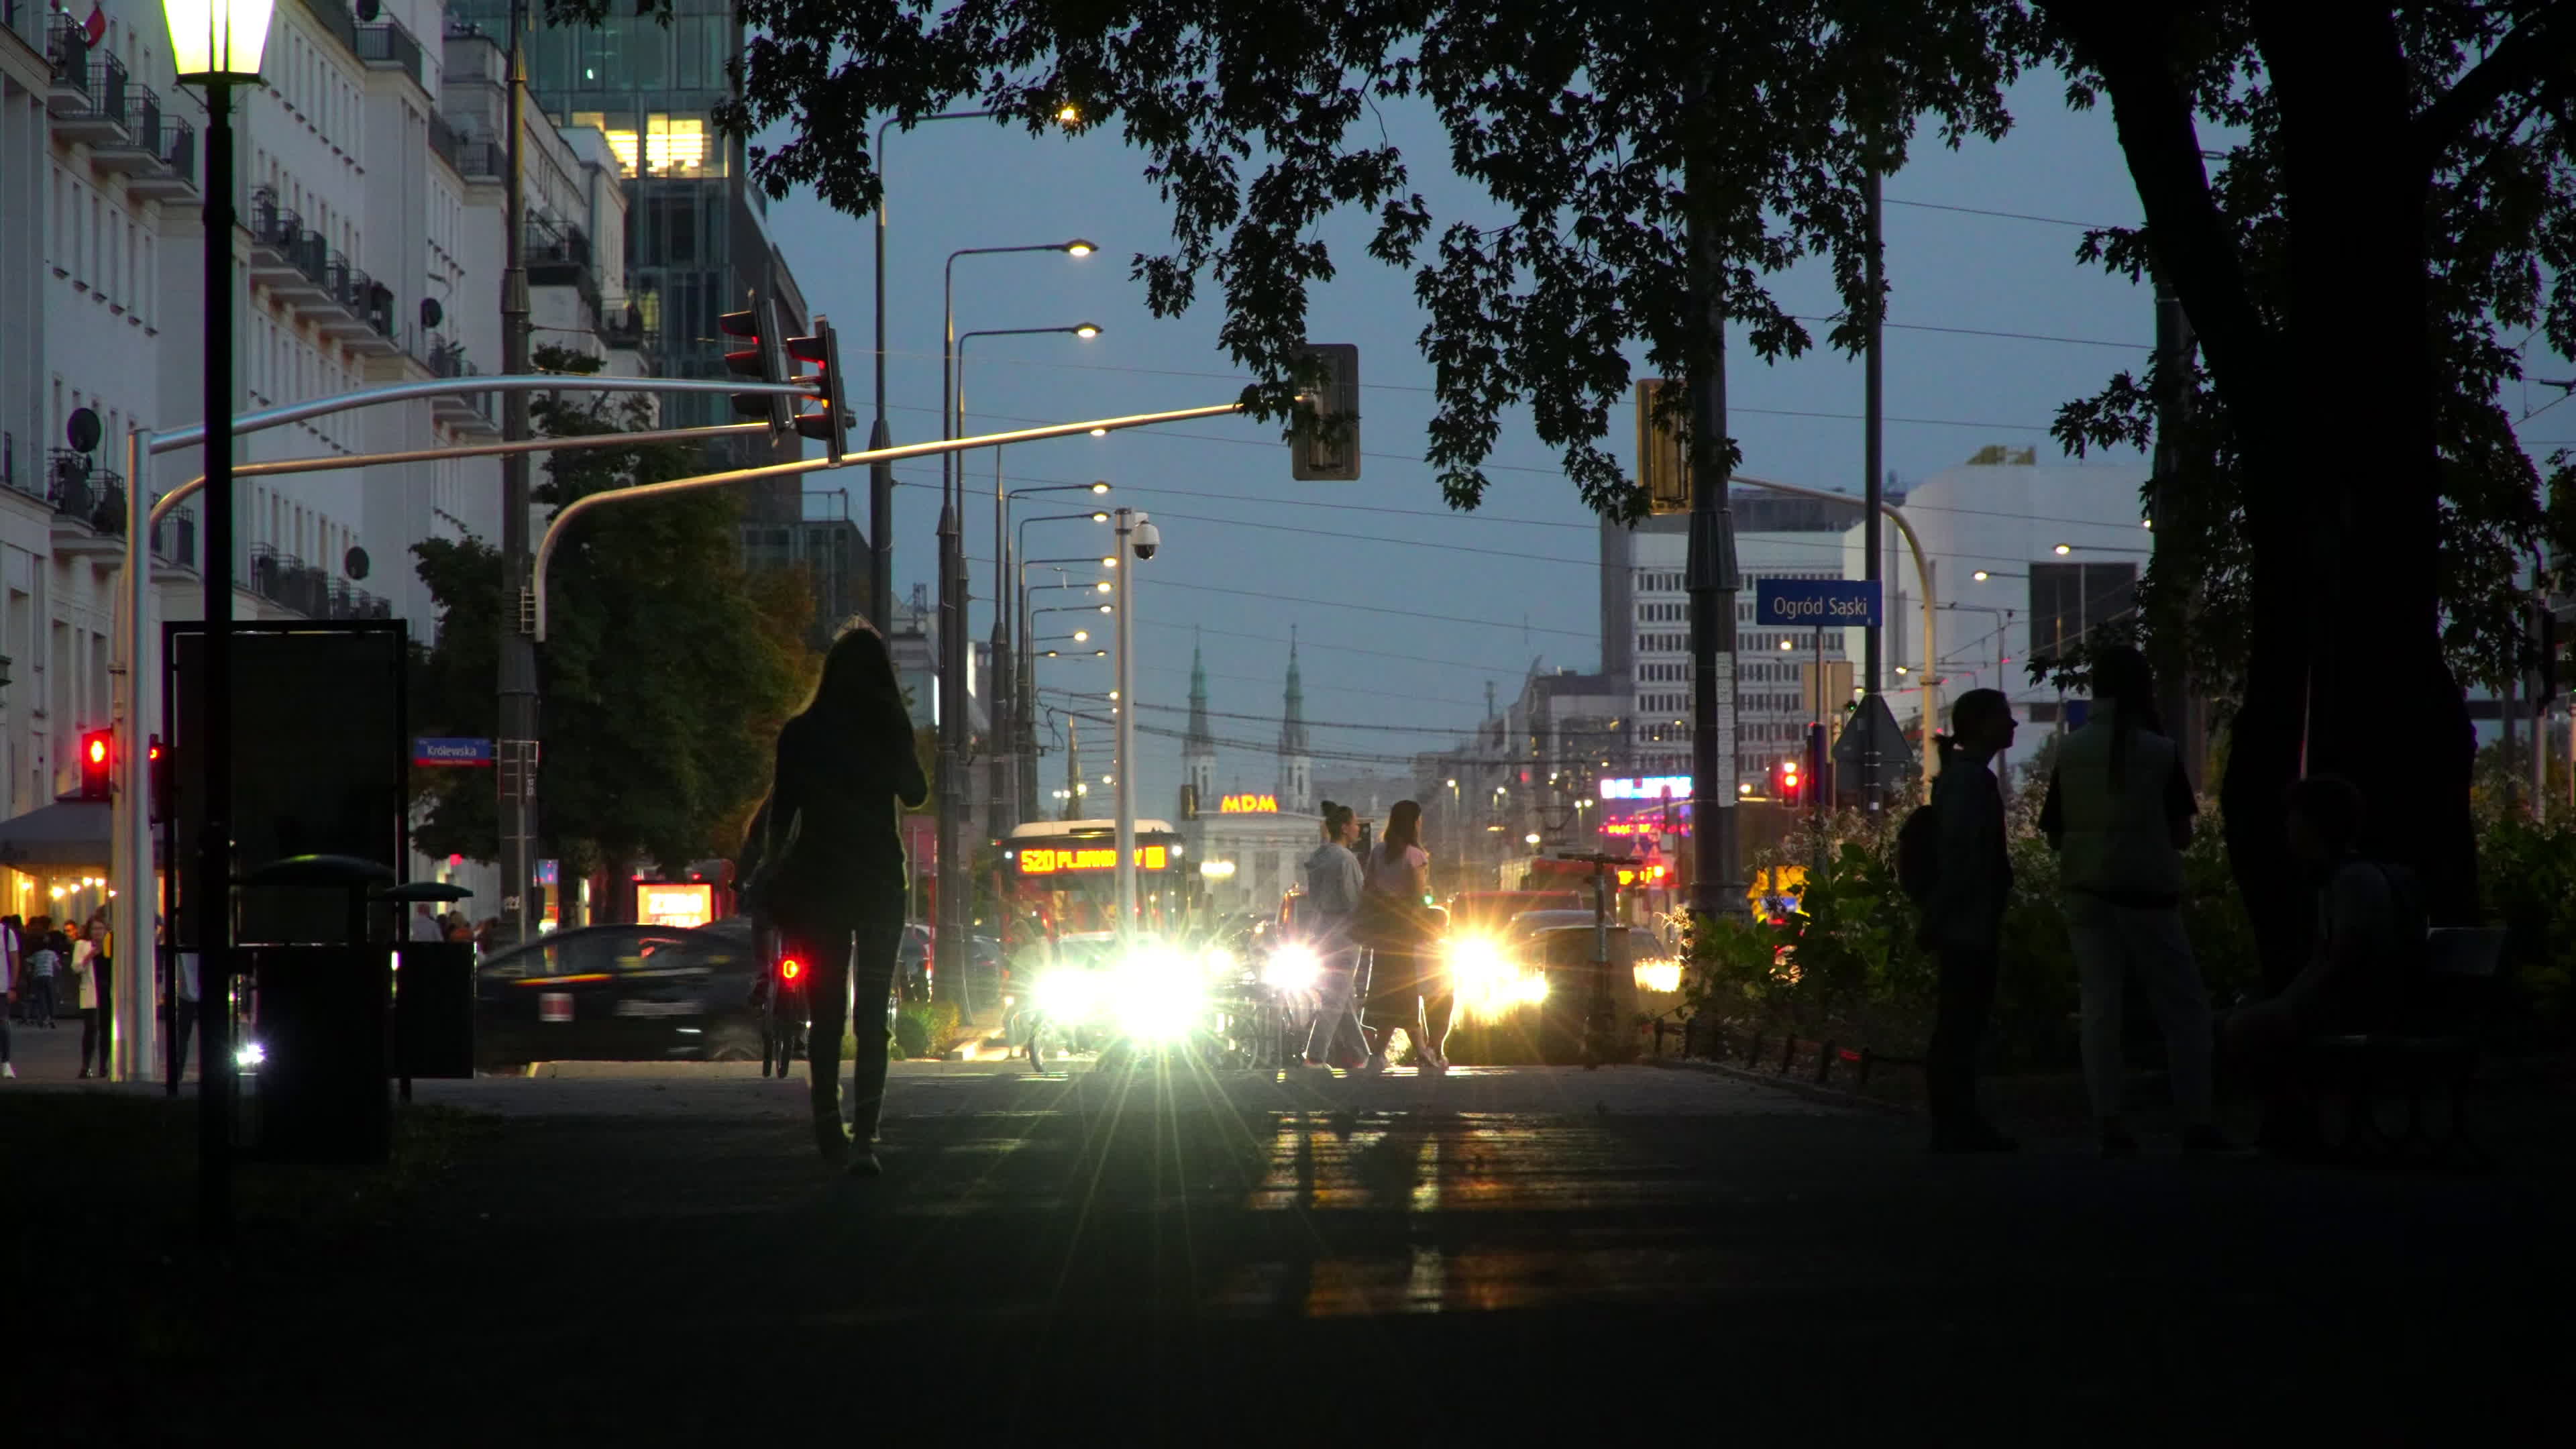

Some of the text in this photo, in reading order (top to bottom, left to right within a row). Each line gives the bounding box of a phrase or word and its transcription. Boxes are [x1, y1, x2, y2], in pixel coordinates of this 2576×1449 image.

[1773, 596, 1867, 620] Ogród Saski
[427, 745, 477, 757] Królewska
[1220, 793, 1279, 814] MDM
[1021, 849, 1055, 872] 520
